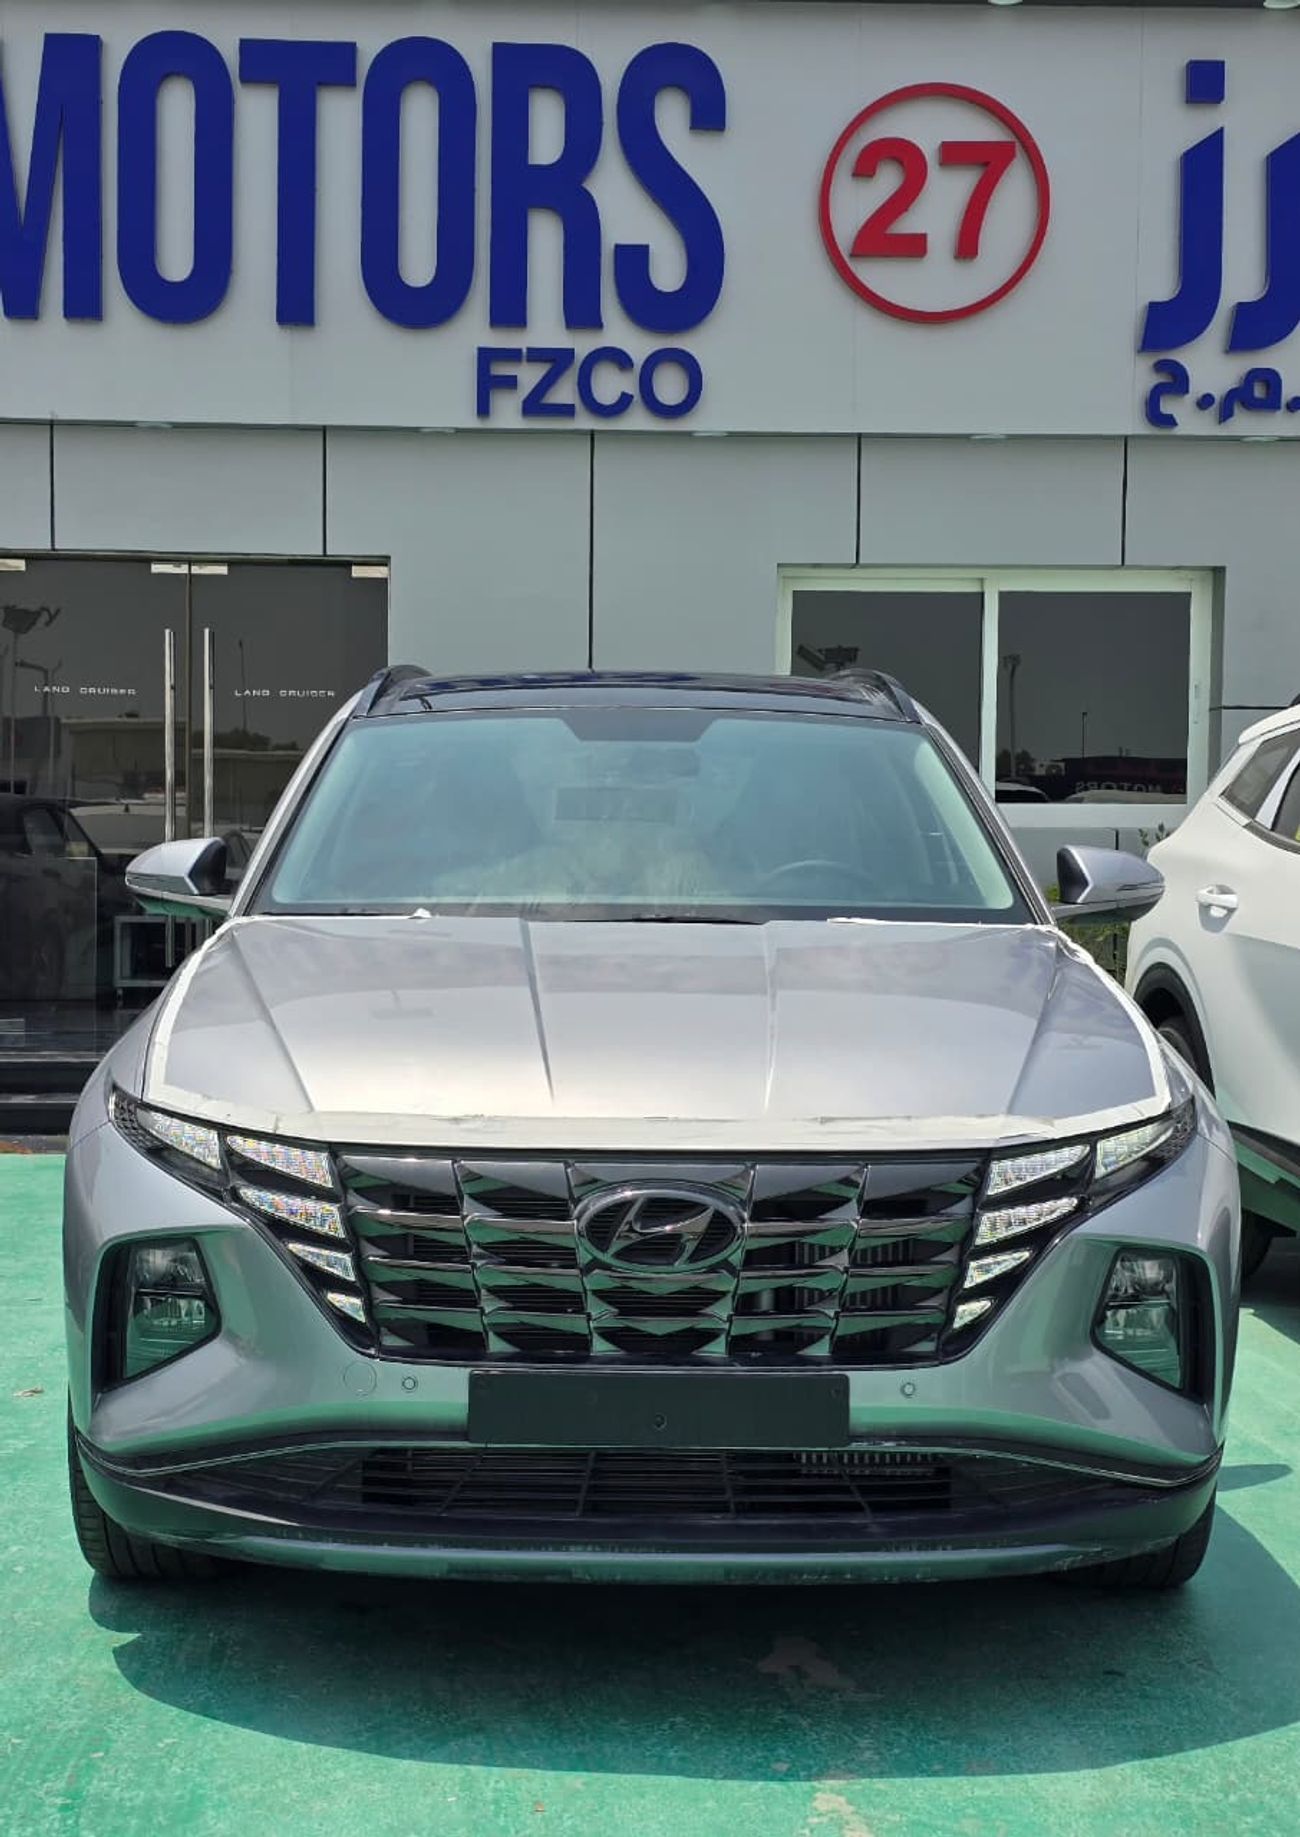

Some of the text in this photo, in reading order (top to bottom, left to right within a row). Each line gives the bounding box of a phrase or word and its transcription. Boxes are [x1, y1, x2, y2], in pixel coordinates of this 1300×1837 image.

[0, 30, 727, 334] MOTORS
[849, 137, 1017, 259] 27
[475, 346, 703, 419] FZCO
[34, 685, 71, 694] LAND
[234, 688, 271, 697] LAND
